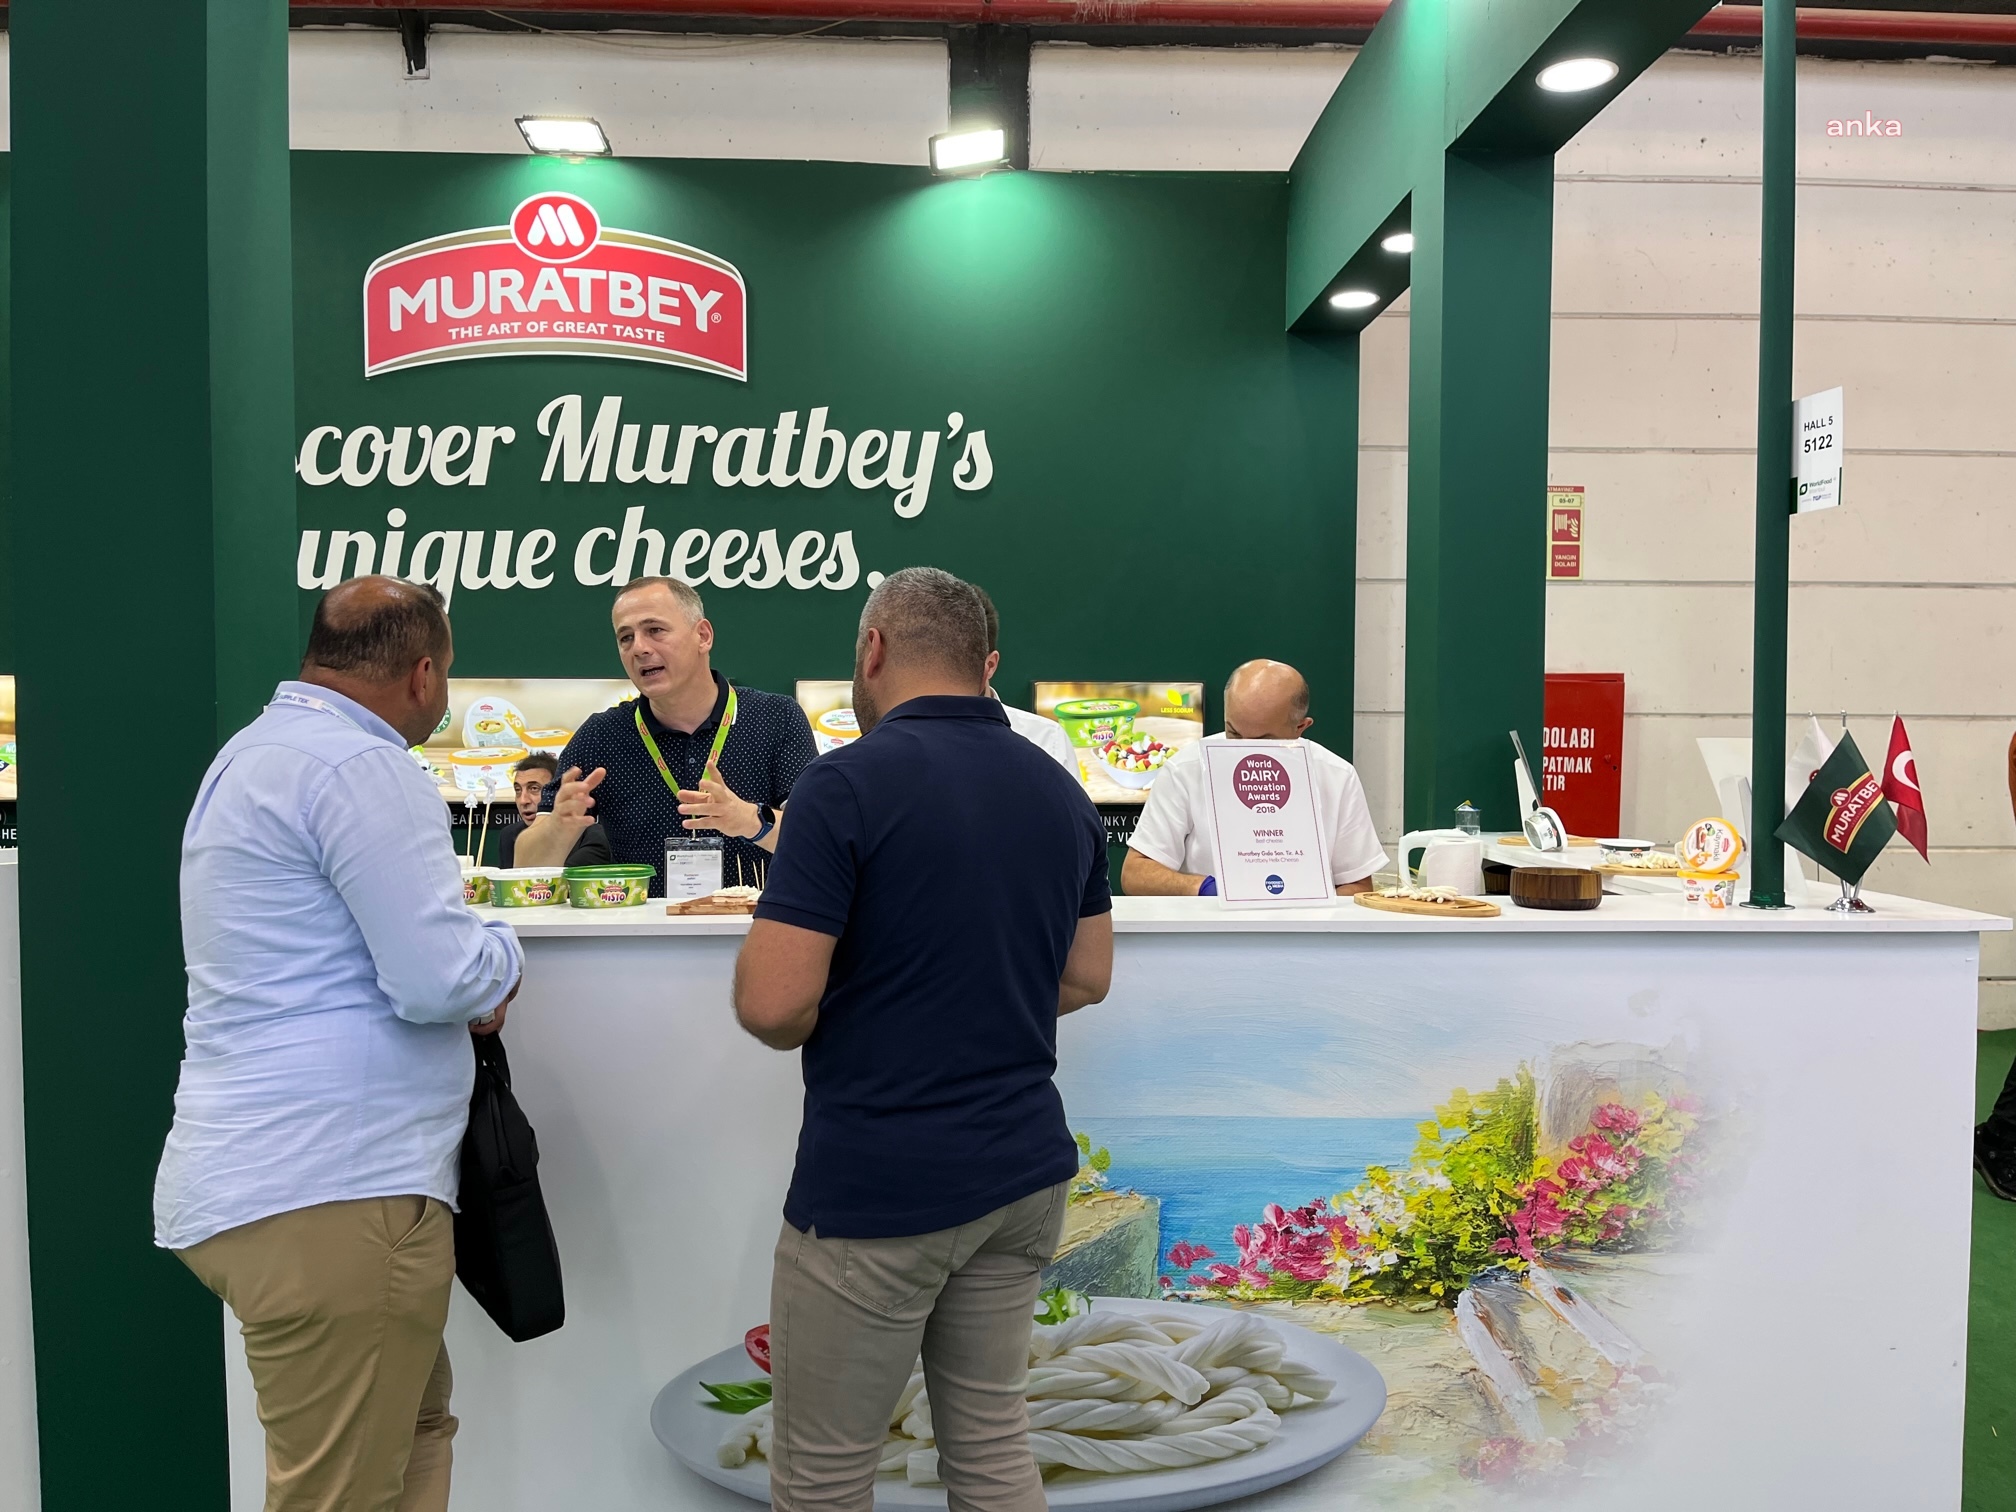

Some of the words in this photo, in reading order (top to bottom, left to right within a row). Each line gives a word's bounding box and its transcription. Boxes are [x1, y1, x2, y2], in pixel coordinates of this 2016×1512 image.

[389, 267, 724, 333] MURATBEY
[448, 324, 483, 340] THE
[487, 321, 521, 336] ART
[525, 321, 549, 333] OF
[552, 320, 608, 336] GREAT
[612, 324, 665, 343] TASTE
[1804, 418, 1826, 432] HALL
[1828, 415, 1834, 426] 5
[1804, 434, 1833, 453] 5122
[295, 425, 516, 487] cover
[297, 508, 557, 615] unique
[1246, 759, 1272, 769] World
[1240, 769, 1280, 782] DAIRY
[1543, 774, 1566, 791] TIR
[1238, 783, 1287, 792] Innovation
[1247, 792, 1281, 801] Awards
[1255, 806, 1276, 814] 2018
[451, 813, 489, 825] EALTH
[1253, 829, 1284, 837] WINNER
